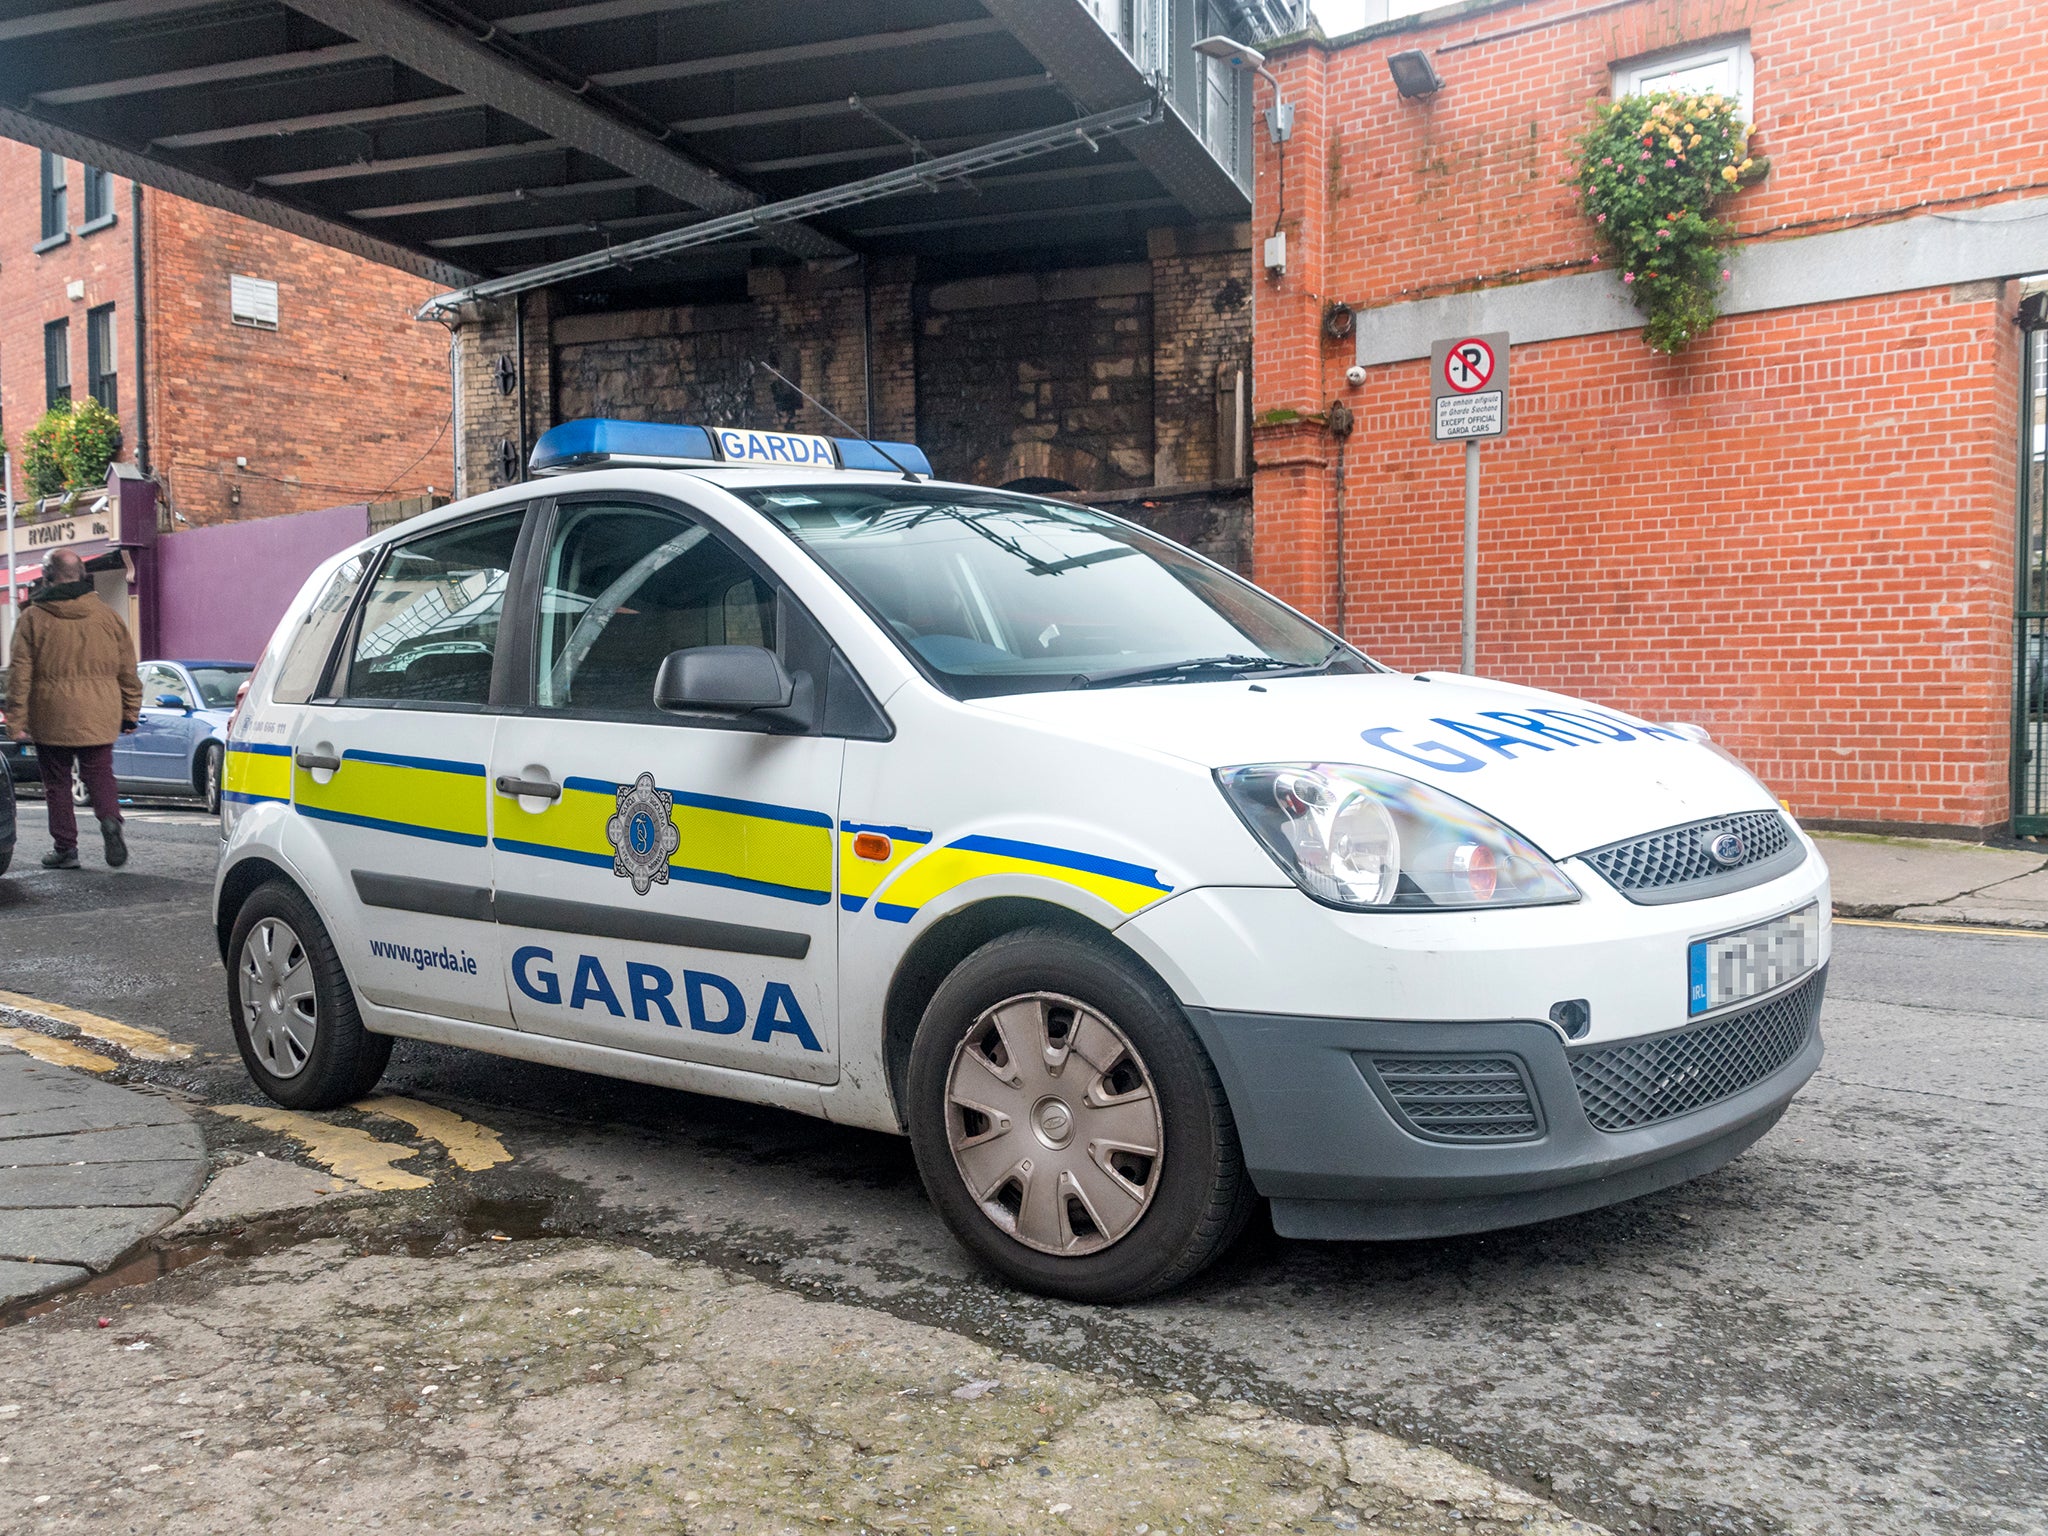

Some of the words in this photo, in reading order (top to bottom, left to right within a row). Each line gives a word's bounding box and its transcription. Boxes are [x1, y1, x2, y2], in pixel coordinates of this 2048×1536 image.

[1441, 417, 1465, 427] EXCEPT
[1468, 414, 1496, 424] OFFICIAL
[1448, 426, 1469, 435] GARDA
[1472, 424, 1490, 433] CARS
[721, 432, 833, 465] GARDA
[28, 521, 75, 546] RYAN'S
[1360, 708, 1689, 773] GARDA
[369, 938, 478, 976] www.garda.ie
[511, 945, 824, 1053] GARDA
[1692, 984, 1706, 1001] IRL
